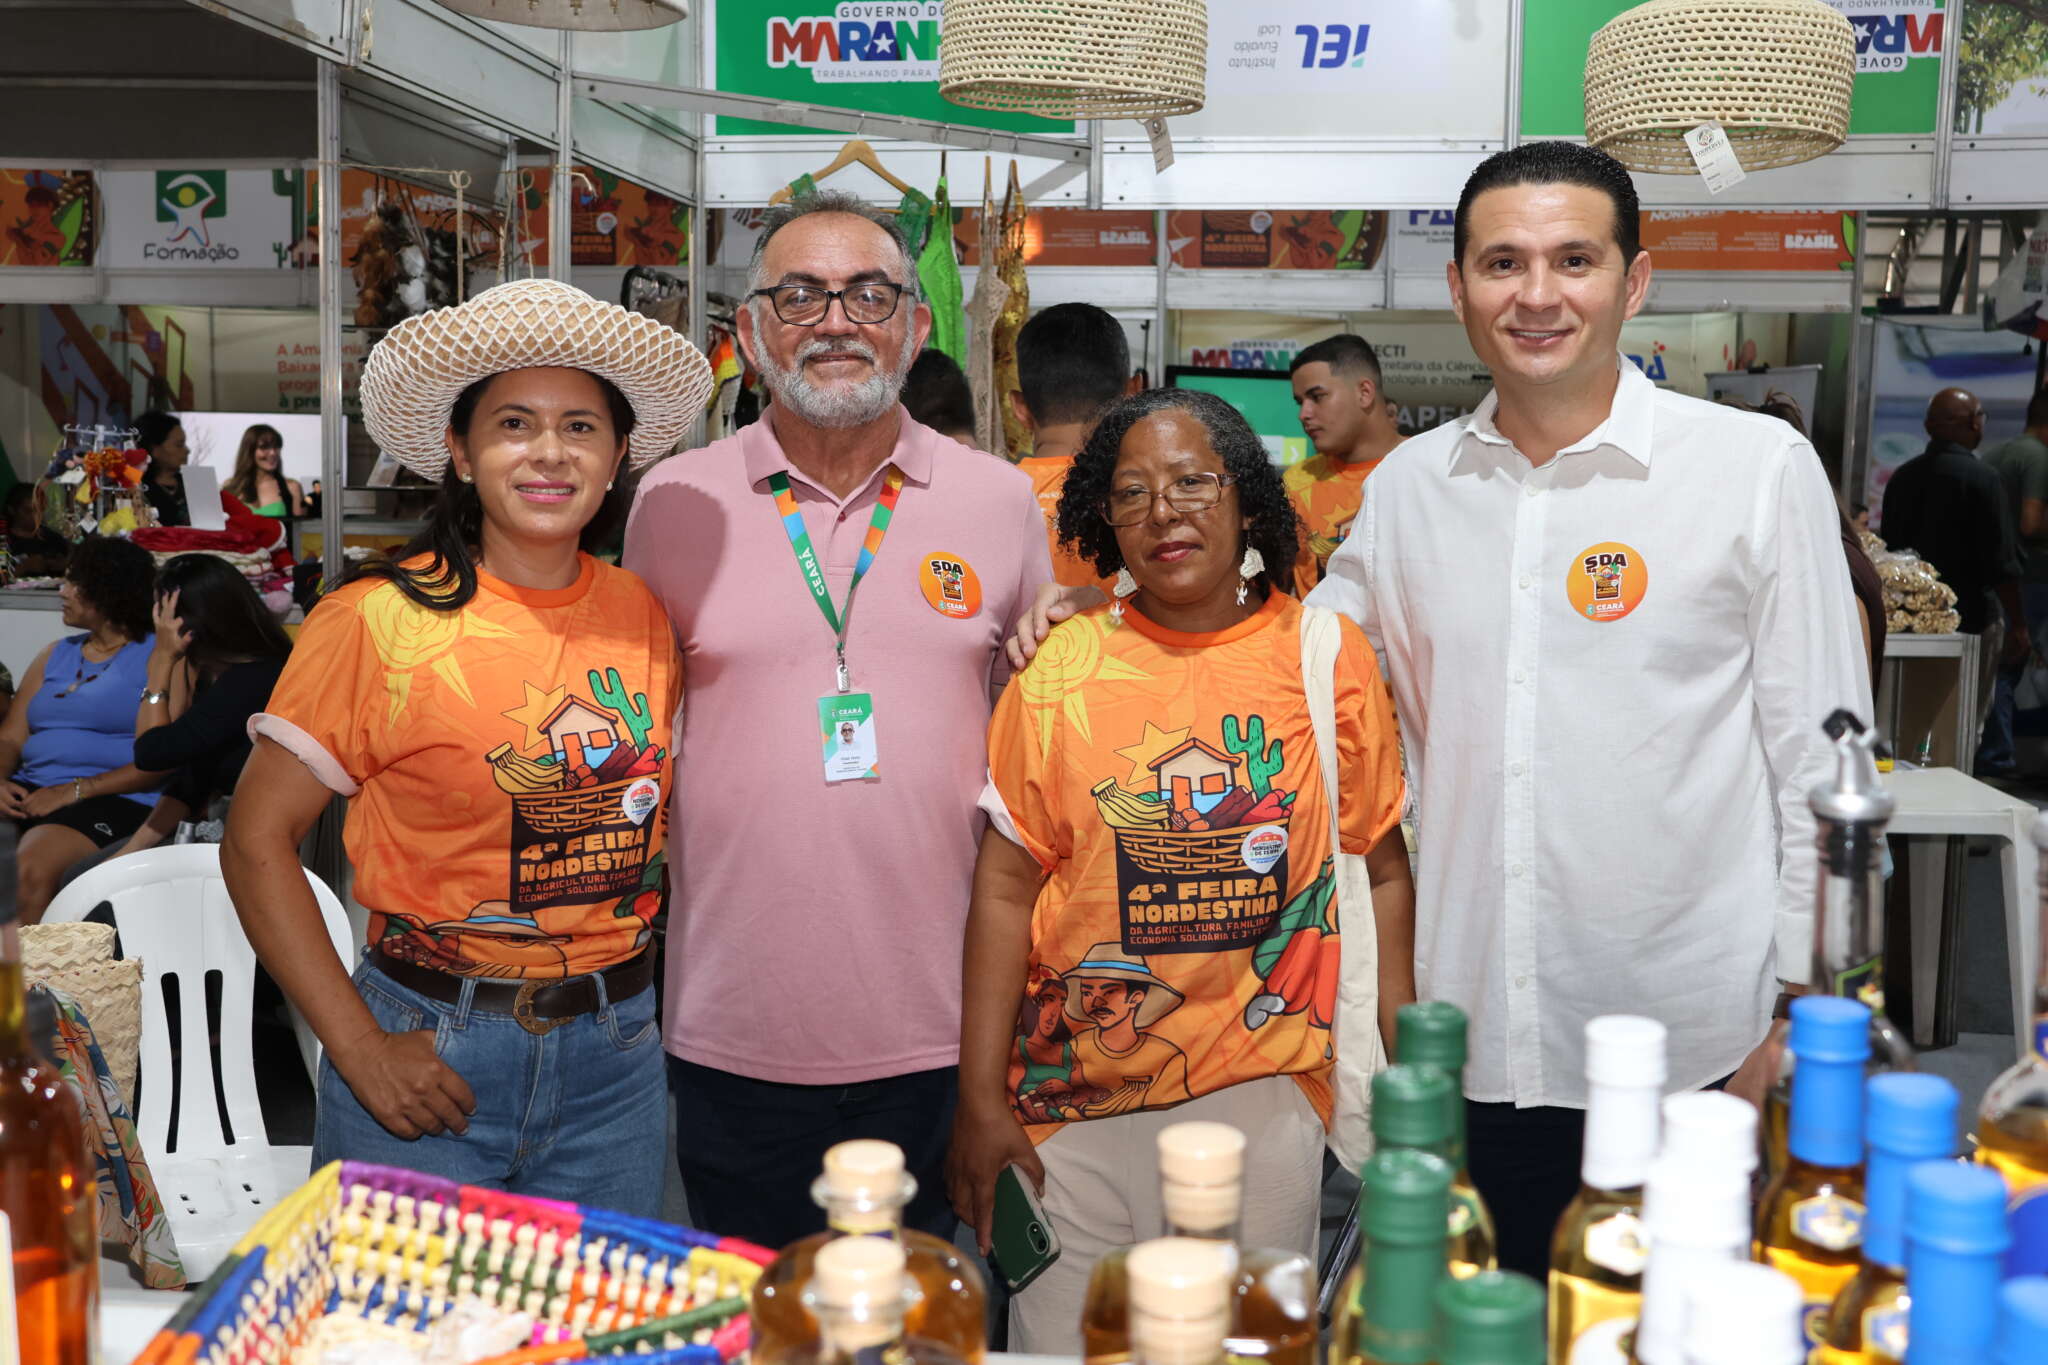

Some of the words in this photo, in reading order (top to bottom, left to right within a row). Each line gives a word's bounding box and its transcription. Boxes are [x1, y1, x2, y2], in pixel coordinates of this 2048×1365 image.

[840, 6, 919, 17] GOVERNO
[1257, 25, 1281, 37] Lodi
[1234, 41, 1278, 53] Euvaldo
[1228, 57, 1276, 69] Instituto
[816, 69, 898, 79] TRABALHANDO
[903, 69, 932, 78] PARA
[1784, 234, 1838, 249] BRASIL
[143, 243, 239, 262] Formação
[931, 561, 963, 576] SDA
[1585, 553, 1627, 569] SDA
[798, 546, 825, 596] CEARÁ
[1596, 601, 1625, 611] CEARÁ
[520, 842, 559, 861] 4ª
[565, 828, 645, 855] FEIRA
[519, 848, 643, 883] NORDESTINA
[520, 885, 533, 894] DA
[536, 873, 606, 892] AGRICULTURA
[1127, 883, 1168, 902] 4ª
[1178, 875, 1279, 900] FEIRA
[519, 889, 563, 903] ECONOMIA
[1129, 895, 1279, 924] NORDESTINA
[1129, 927, 1144, 936] DA
[1147, 922, 1222, 936] AGRICULTURA
[1130, 936, 1176, 945] ECONOMIA
